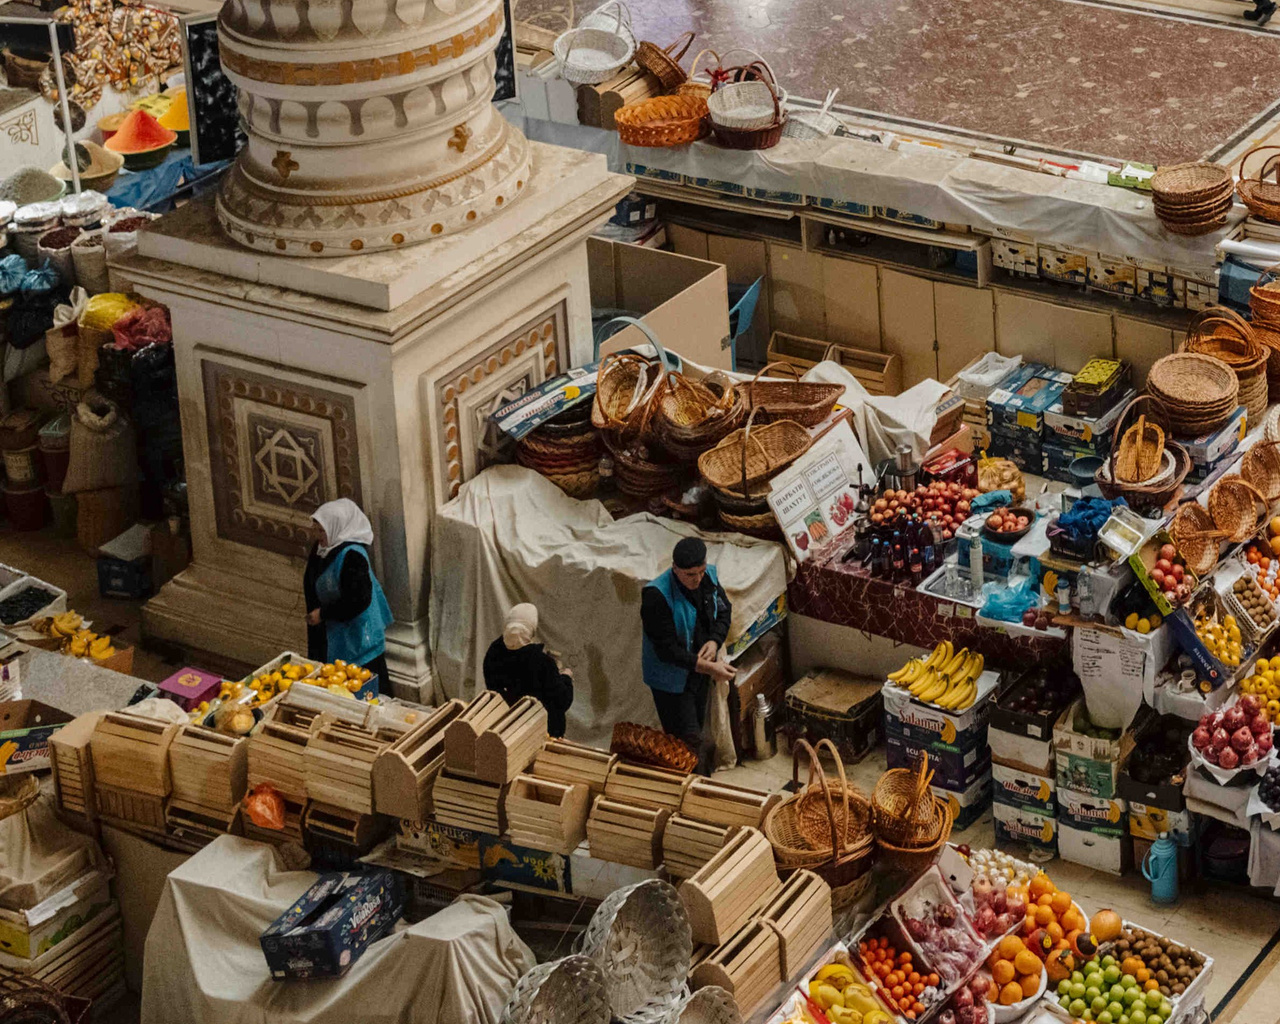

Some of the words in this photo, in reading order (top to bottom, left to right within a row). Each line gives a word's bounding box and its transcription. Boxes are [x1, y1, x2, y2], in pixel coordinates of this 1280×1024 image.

[775, 483, 804, 507] ШАРБАТИ
[782, 493, 807, 515] ШАХТУТ
[898, 709, 943, 732] Salamat
[1002, 779, 1039, 798] Maestro
[1068, 802, 1110, 820] Salamat
[1003, 819, 1043, 839] Salamat
